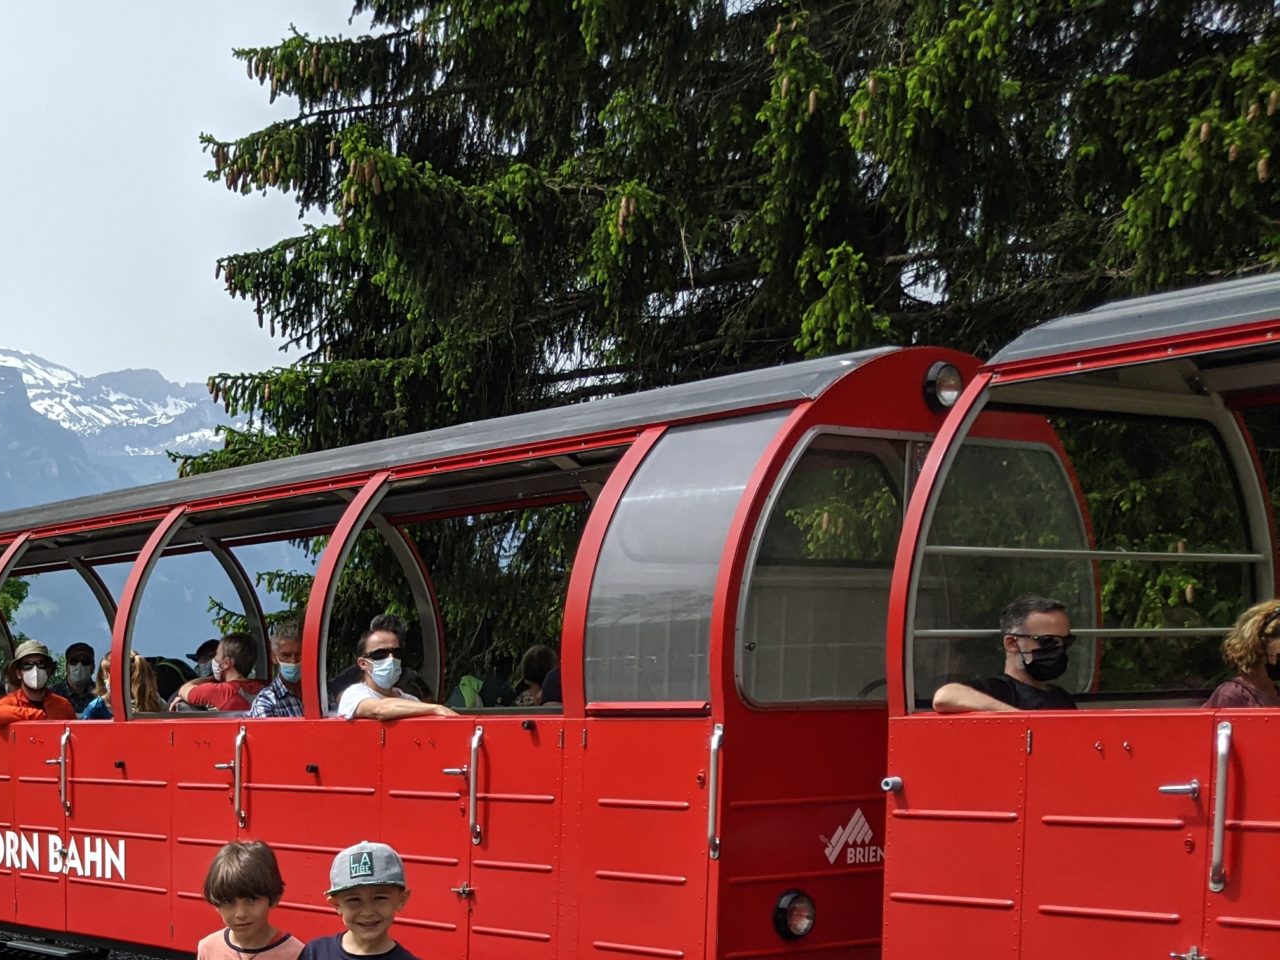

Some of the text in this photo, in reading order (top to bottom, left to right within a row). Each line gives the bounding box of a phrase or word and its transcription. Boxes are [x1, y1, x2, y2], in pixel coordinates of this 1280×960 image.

[48, 834, 126, 880] BAHN
[350, 852, 371, 867] LA
[351, 864, 372, 874] VIBE
